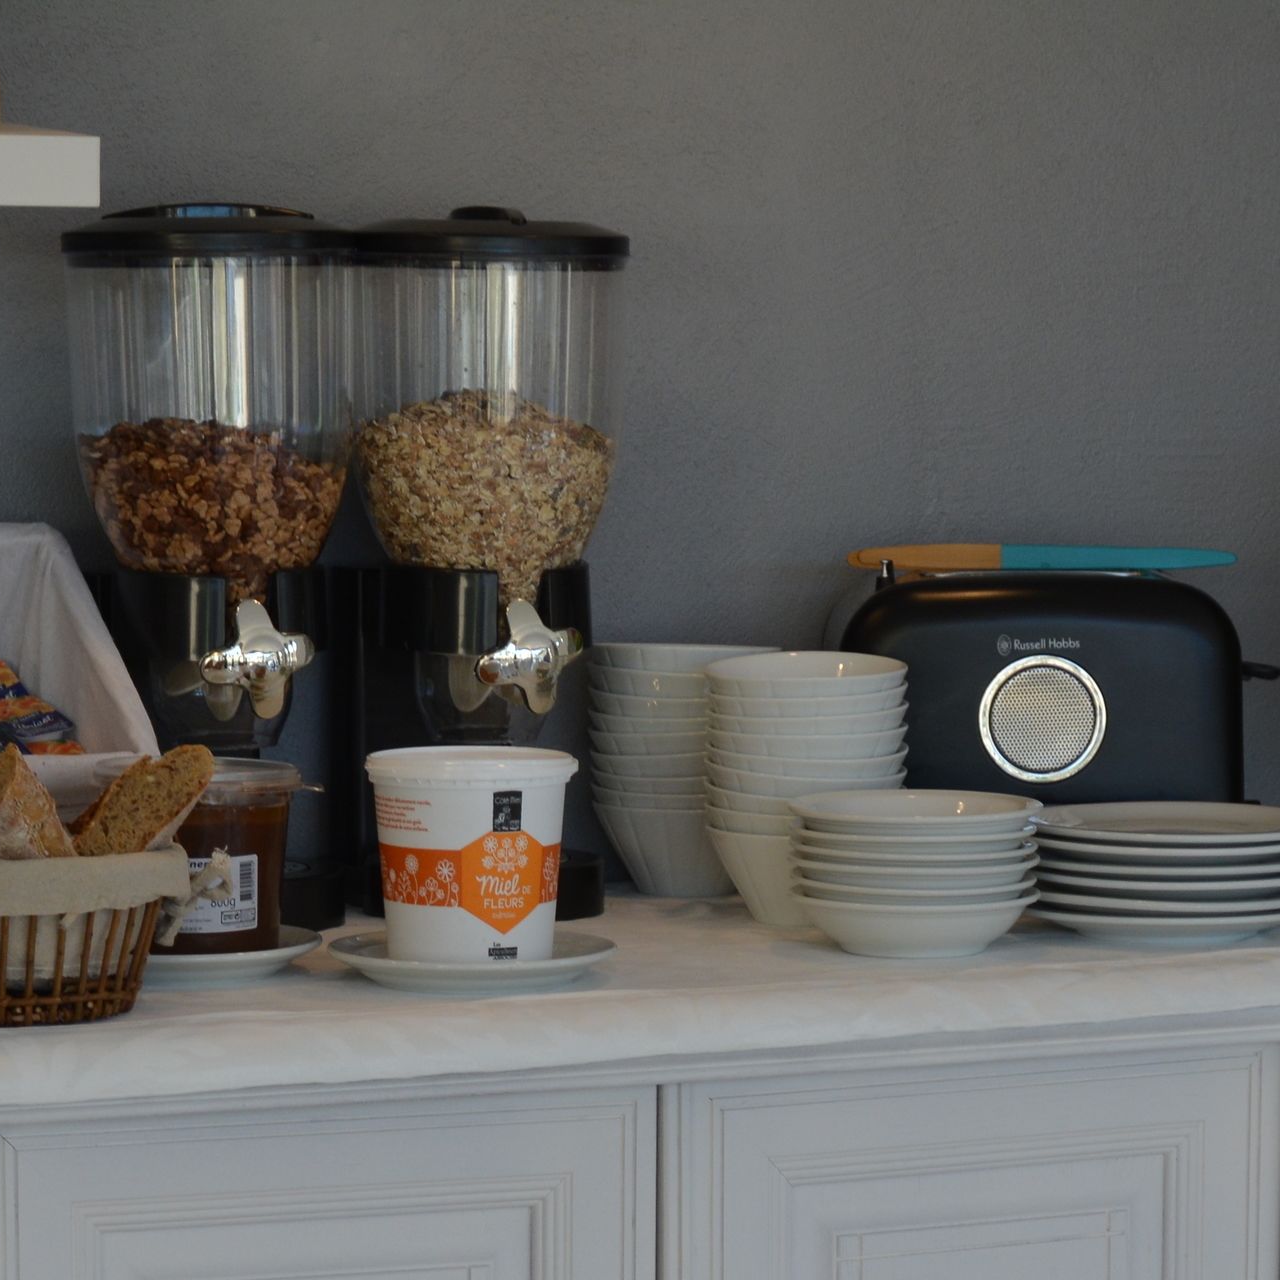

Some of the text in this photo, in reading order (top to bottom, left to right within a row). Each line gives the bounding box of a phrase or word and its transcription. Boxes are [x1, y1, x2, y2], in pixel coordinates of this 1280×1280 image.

[1013, 636, 1081, 651] Russell Hobbs
[475, 873, 520, 897] Miel
[483, 896, 525, 909] FLEURS
